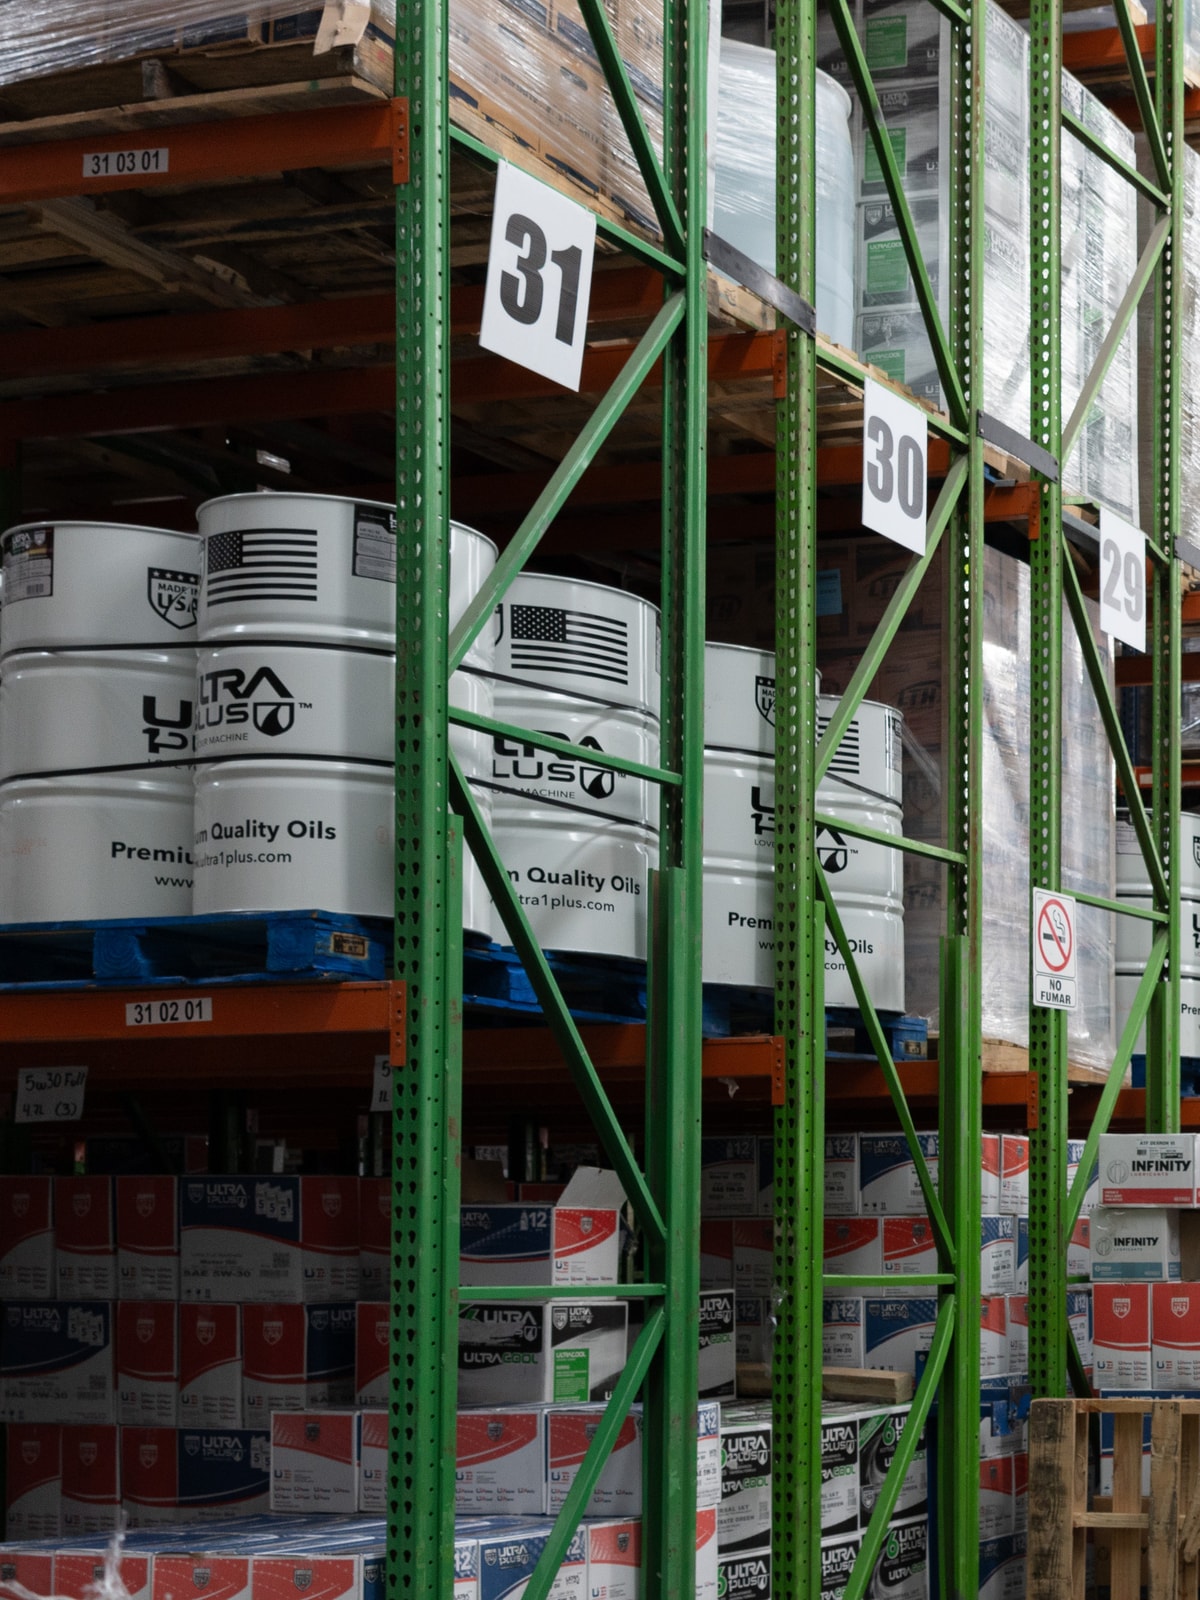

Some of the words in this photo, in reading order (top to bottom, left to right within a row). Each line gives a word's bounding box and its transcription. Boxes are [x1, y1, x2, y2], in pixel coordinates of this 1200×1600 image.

[91, 153, 109, 174] 31
[114, 152, 135, 172] 03
[140, 150, 161, 171] 01
[500, 213, 583, 347] 31
[866, 414, 924, 520] 30
[158, 583, 186, 594] MADE
[1102, 538, 1143, 623] 29
[200, 667, 294, 705] LTRA
[762, 689, 775, 697] MAD
[197, 703, 248, 731] LUS
[208, 733, 248, 745] MACHINE
[493, 760, 576, 782] LUS
[521, 788, 576, 799] MACHINE
[211, 819, 280, 843] Quality
[287, 820, 337, 840] Oils
[111, 841, 194, 865] Premiu
[195, 850, 292, 868] ultra1plus.com
[527, 867, 605, 893] Quality
[611, 875, 640, 895] Oils
[518, 893, 615, 912] tra1plus.com
[728, 912, 775, 930] Premi
[1049, 978, 1062, 991] NO
[1040, 991, 1071, 1005] FUMAR
[133, 1003, 153, 1024] 31
[159, 1001, 179, 1022] 02
[184, 999, 204, 1020] 01
[55, 1101, 77, 1116] (3)
[834, 1140, 849, 1153] 12
[1132, 1160, 1191, 1172] INFINITY
[206, 1184, 247, 1196] ULTRA
[529, 1211, 547, 1228] 12
[1113, 1237, 1159, 1247] INFINITY
[23, 1307, 61, 1320] ULTRA
[484, 1310, 537, 1325] ULTRA
[569, 1307, 592, 1316] ULTRA
[839, 1303, 856, 1317] 12
[463, 1352, 538, 1365] ULTRACOOL
[882, 1413, 896, 1446] 6
[201, 1435, 243, 1449] ULTRA
[728, 1436, 767, 1450] ULTRA
[722, 1475, 768, 1492] LTRACOOL
[499, 1545, 528, 1556] ULTRA
[886, 1528, 899, 1560] 6
[822, 1547, 857, 1563] ULTRA
[728, 1560, 767, 1578] ULTRA
